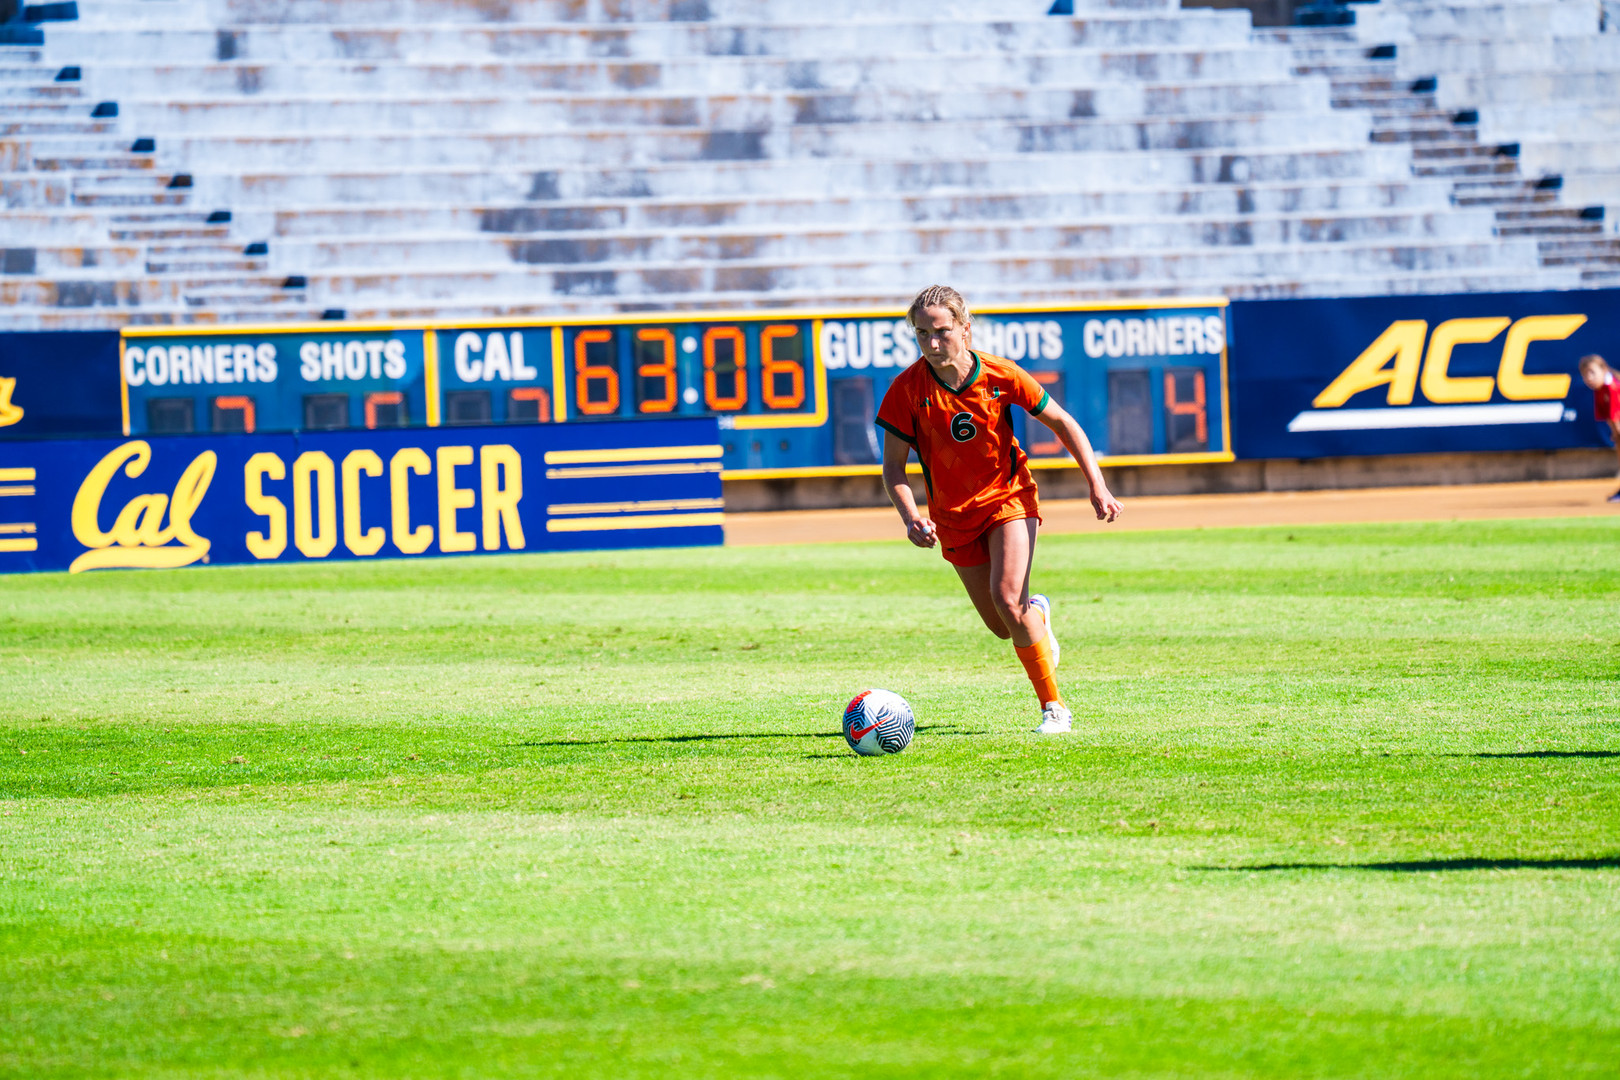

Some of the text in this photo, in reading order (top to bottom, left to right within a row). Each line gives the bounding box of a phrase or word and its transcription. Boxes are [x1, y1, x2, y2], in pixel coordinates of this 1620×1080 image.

[124, 339, 407, 386] CORNERS SHOTS
[454, 332, 537, 383] CAL
[574, 325, 805, 415] 63:06
[820, 320, 924, 369] GUES
[1083, 316, 1224, 358] CORNERS
[1312, 314, 1588, 408] ACC
[950, 411, 977, 442] 6
[1164, 371, 1207, 443] 4
[69, 440, 526, 573] Cal SOCCER
